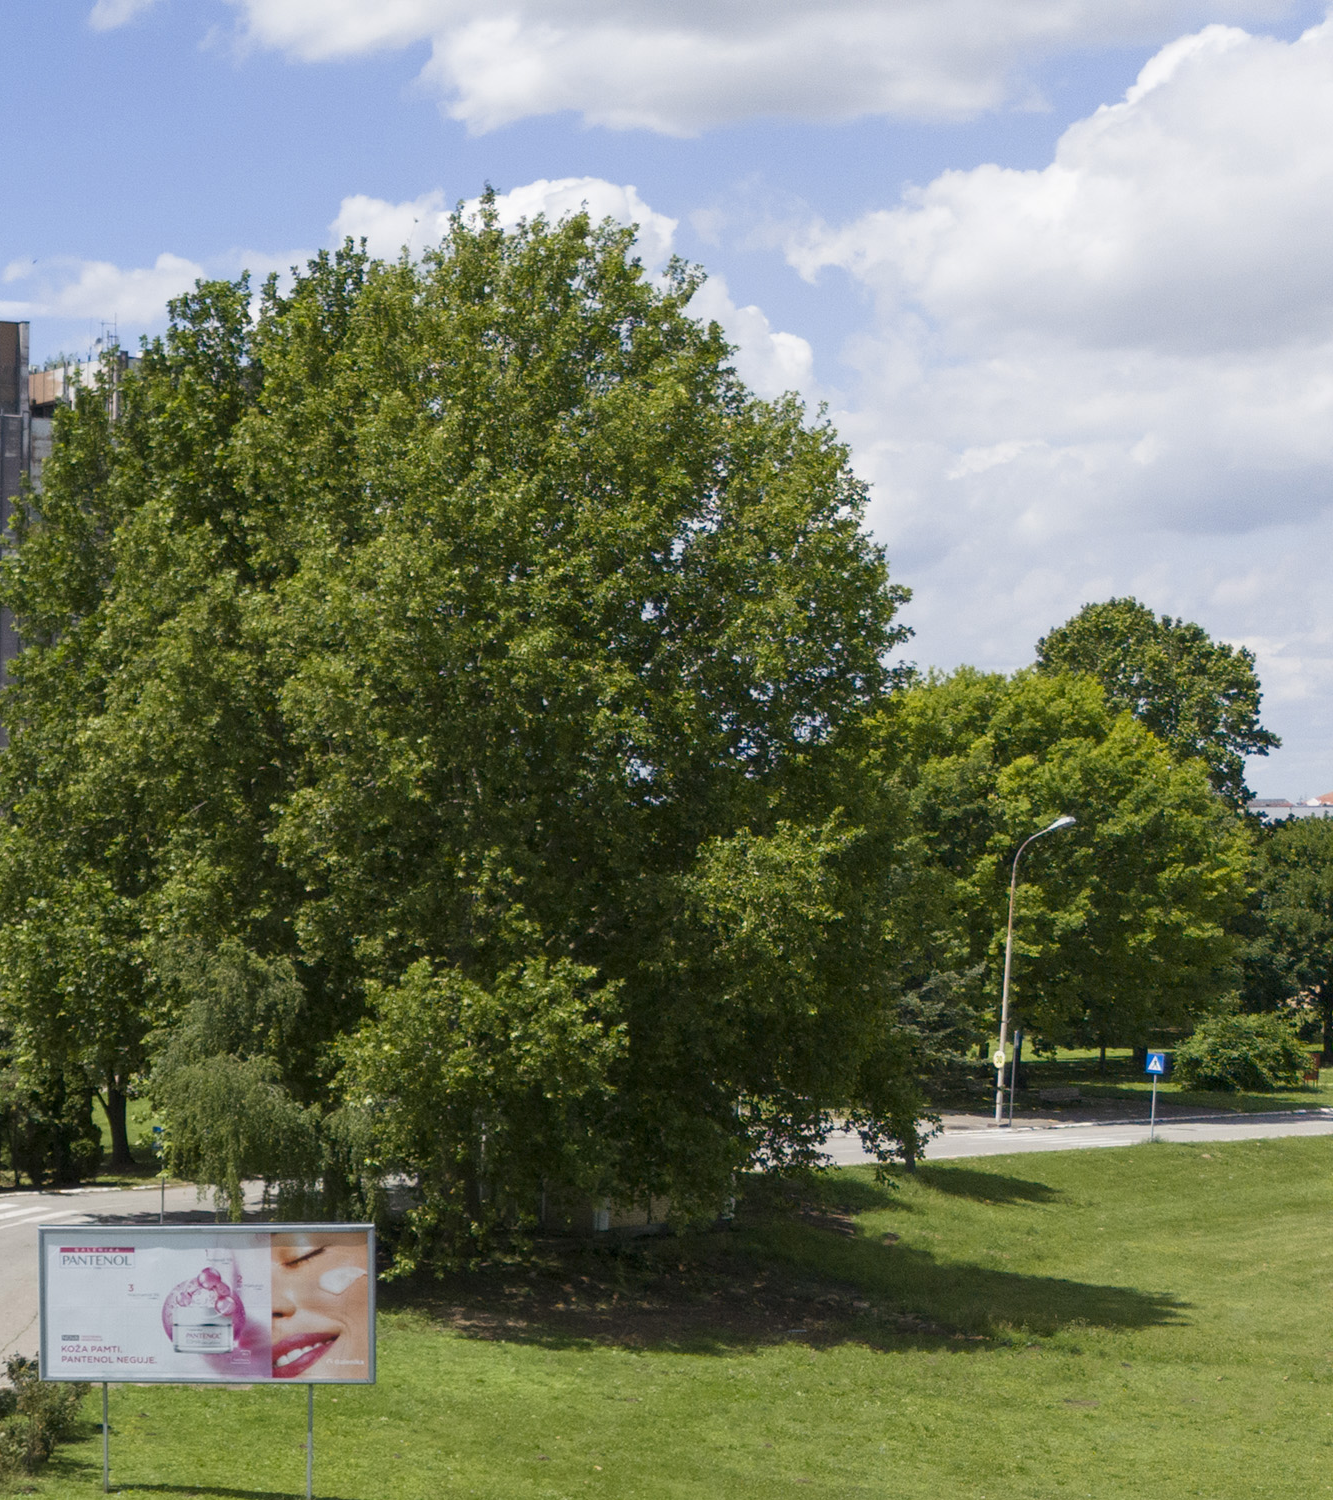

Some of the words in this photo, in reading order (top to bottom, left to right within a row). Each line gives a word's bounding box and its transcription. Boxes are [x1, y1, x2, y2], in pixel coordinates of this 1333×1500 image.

[62, 1255, 132, 1266] PANTENOL
[61, 1344, 88, 1353] KOŽA
[91, 1345, 122, 1353] PAMTI.
[61, 1355, 114, 1364] PANTENOL
[116, 1356, 157, 1364] NEGUJE.
